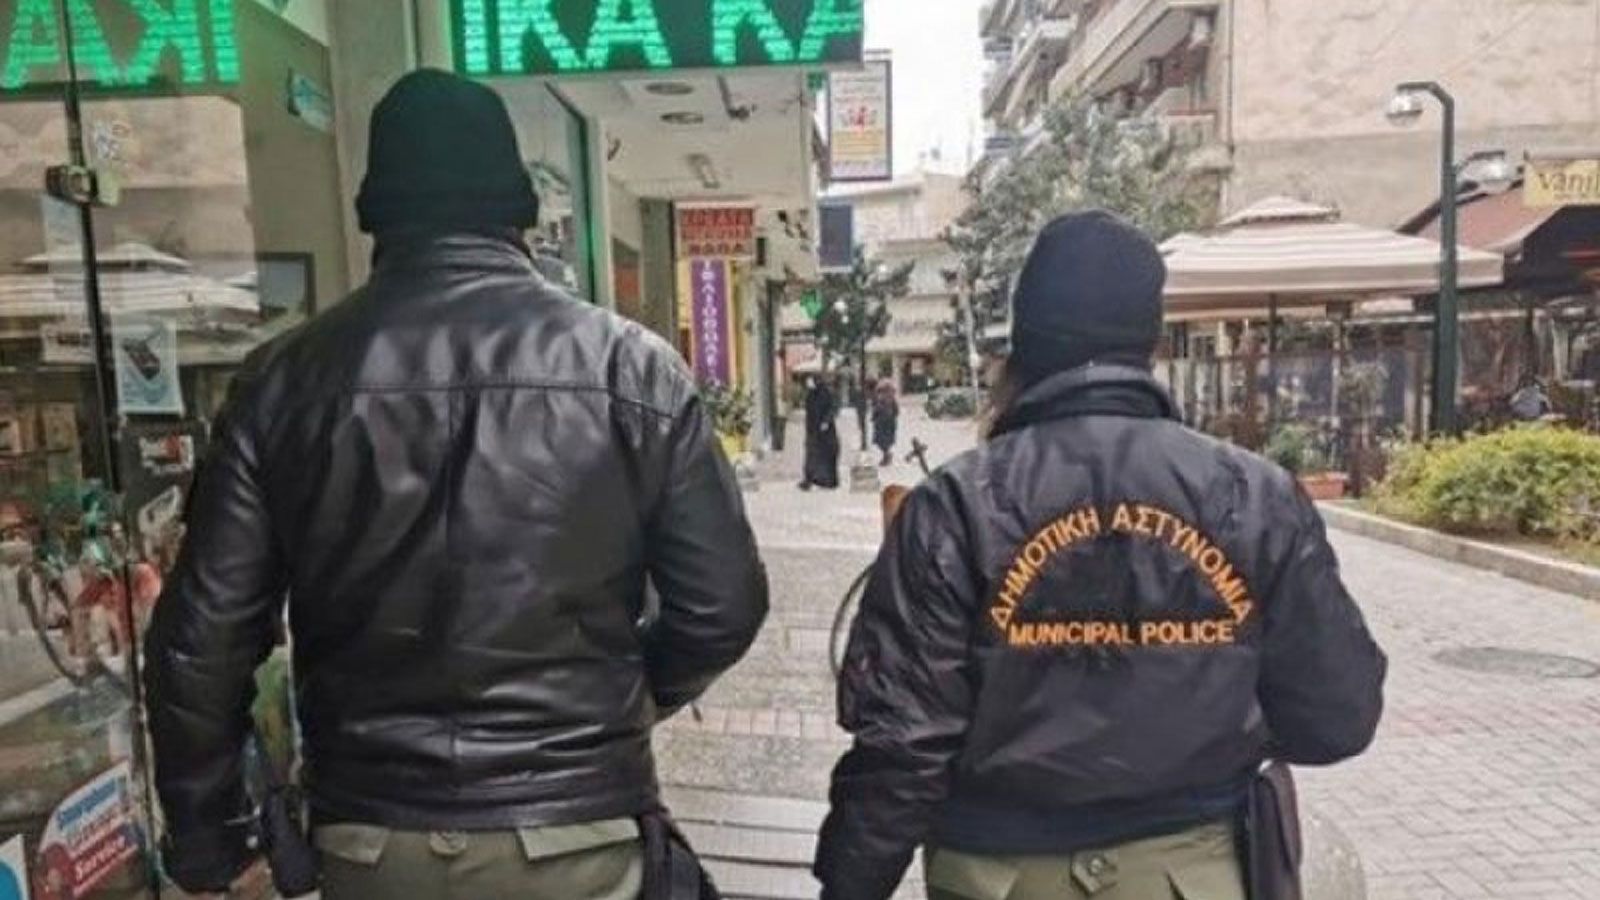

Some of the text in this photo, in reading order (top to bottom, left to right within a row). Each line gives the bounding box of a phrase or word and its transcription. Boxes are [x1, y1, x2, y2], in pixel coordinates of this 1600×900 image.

[990, 502, 1252, 630] ΔΗΜΟΤΙΚΗ ΑΣΤΥΝΟΜΙΑ
[1008, 619, 1235, 645] MUNICIPAL POLICE
